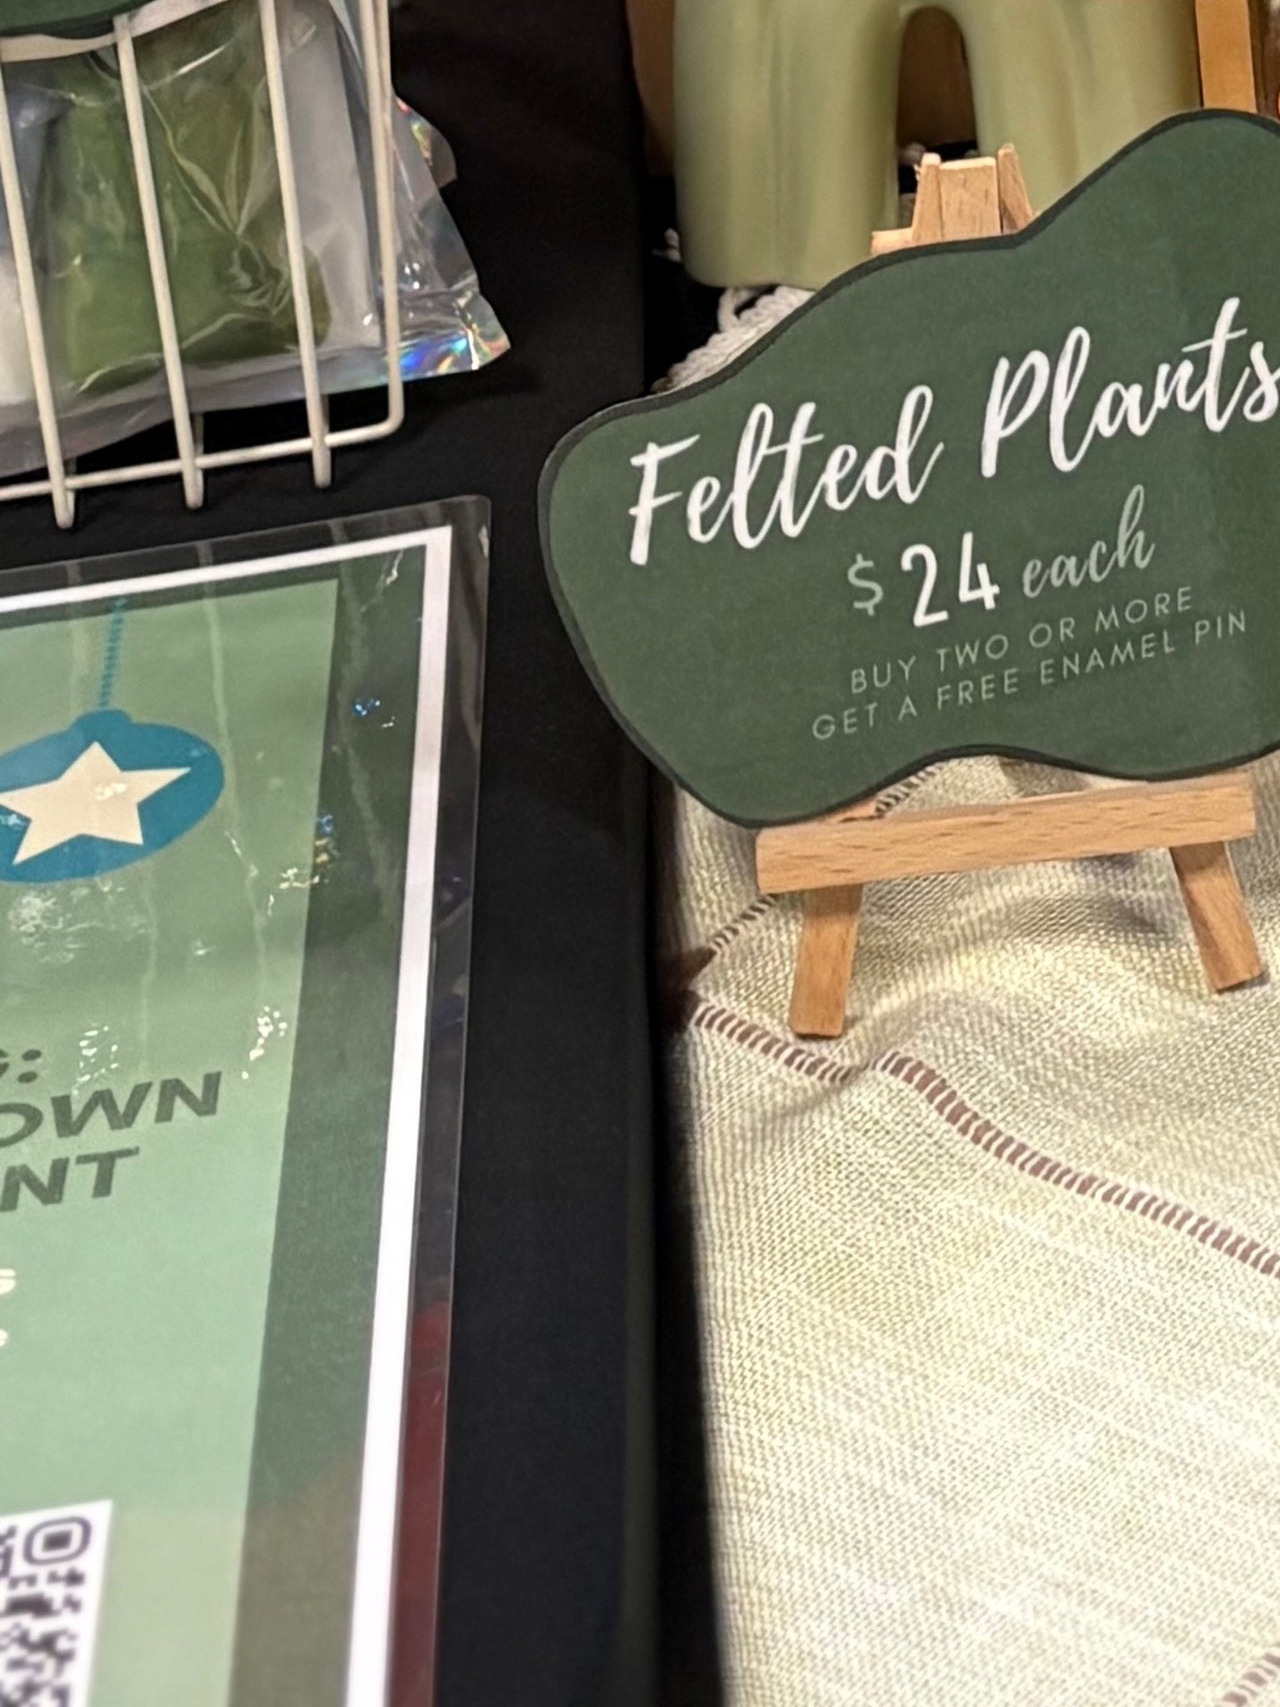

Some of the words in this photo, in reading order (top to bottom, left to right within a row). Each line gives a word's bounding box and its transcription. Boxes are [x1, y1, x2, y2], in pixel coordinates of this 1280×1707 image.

[628, 385, 945, 566] Felted
[1021, 483, 1157, 600] each
[811, 701, 880, 743] GET
[897, 694, 920, 722] A
[937, 667, 1021, 713] FREE
[1039, 633, 1178, 688] ENAMEL
[1194, 608, 1248, 648] PIN
[849, 654, 915, 696] BUY
[936, 633, 1010, 675] TWO
[1028, 614, 1077, 651] OR
[1094, 584, 1195, 636] MORE
